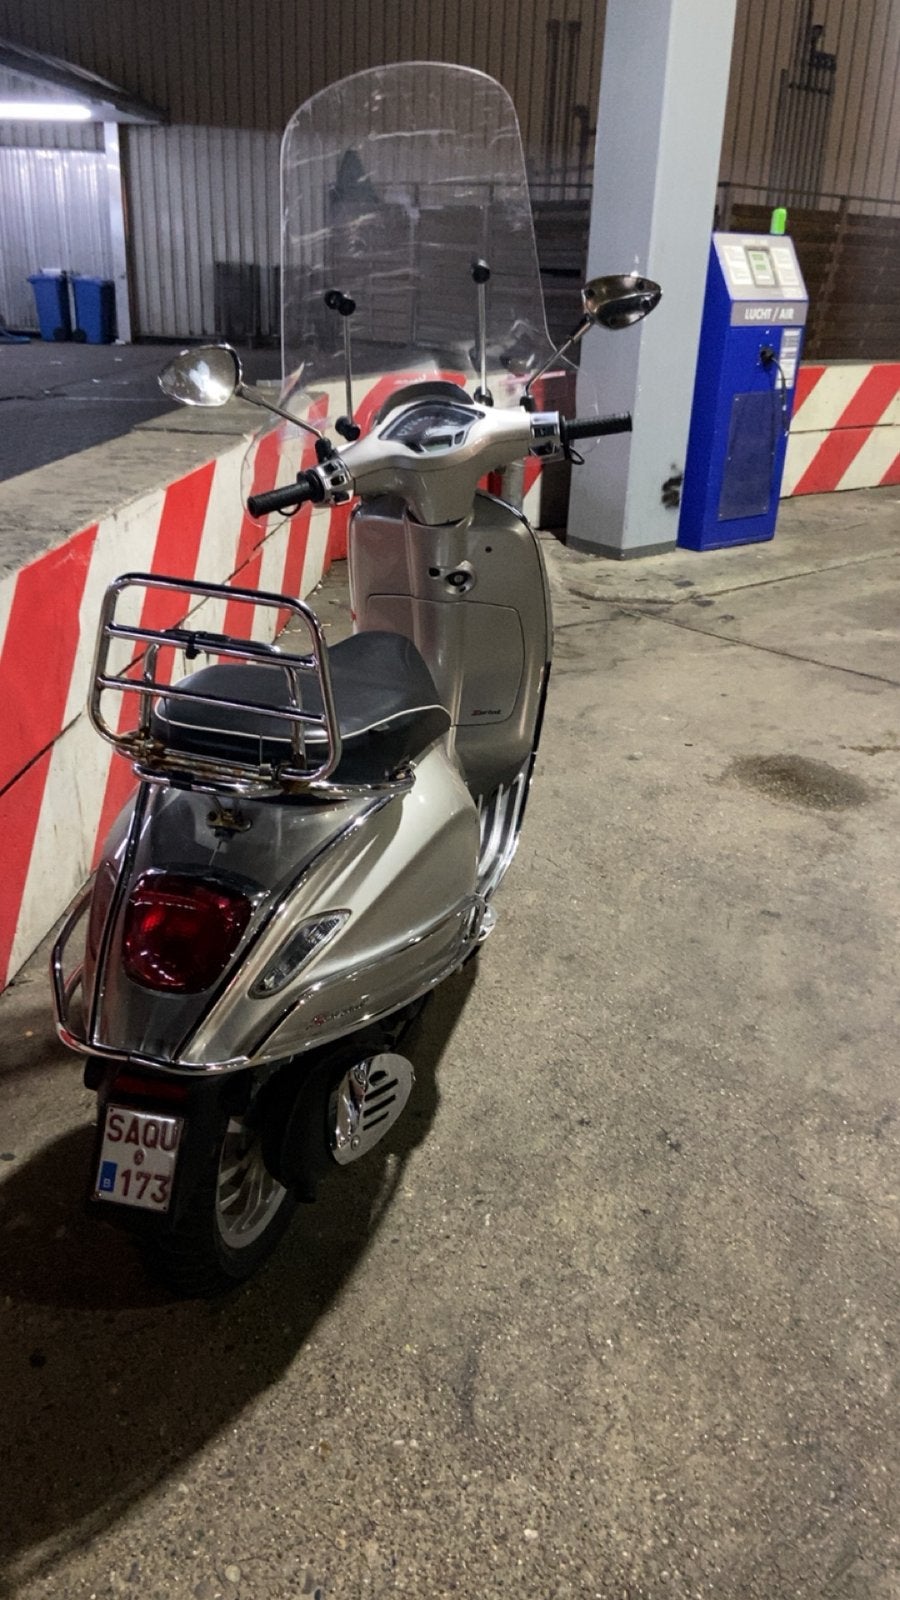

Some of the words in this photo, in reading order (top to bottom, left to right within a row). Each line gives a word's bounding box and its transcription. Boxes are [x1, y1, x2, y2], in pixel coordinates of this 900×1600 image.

[744, 308, 772, 320] LUCHT
[779, 308, 795, 320] AIR
[107, 1114, 179, 1151] SAQU
[103, 1178, 112, 1188] B
[121, 1169, 171, 1203] 173
